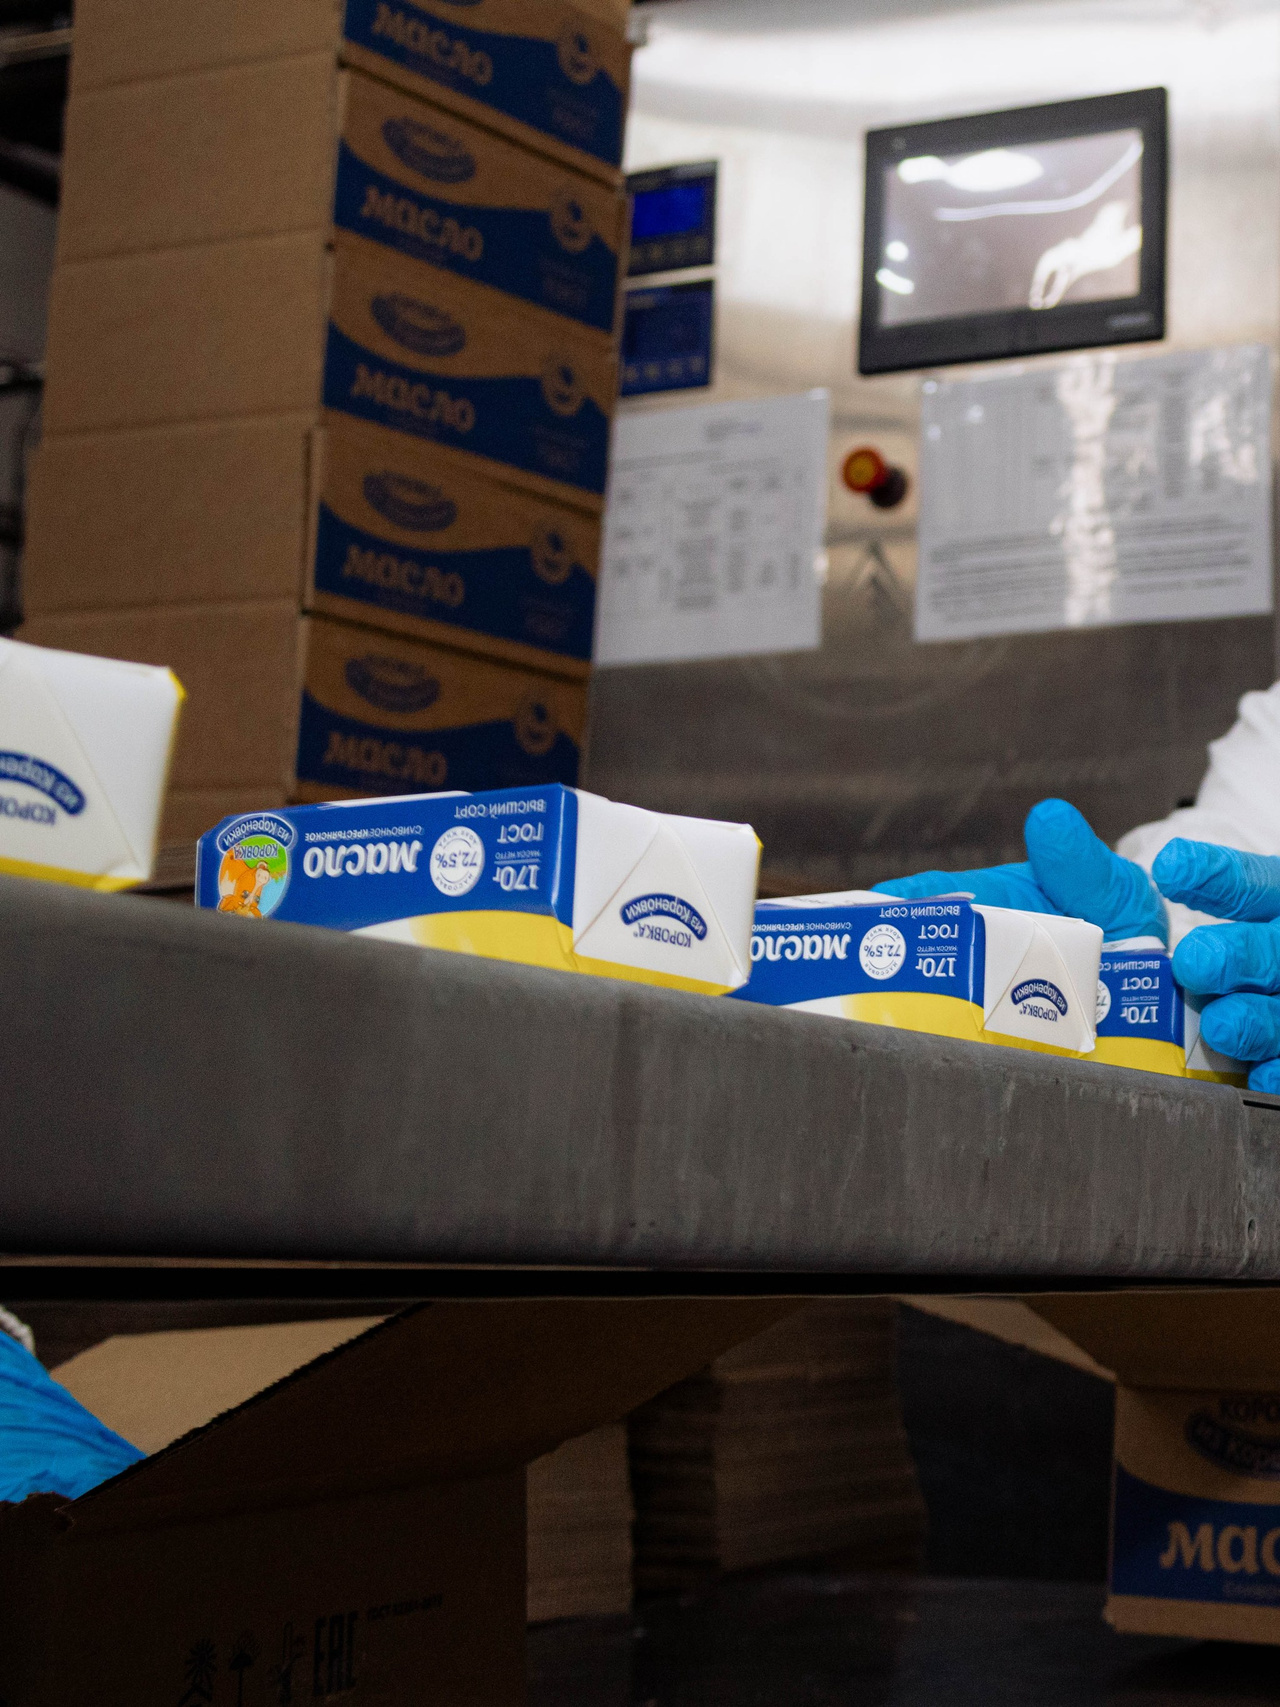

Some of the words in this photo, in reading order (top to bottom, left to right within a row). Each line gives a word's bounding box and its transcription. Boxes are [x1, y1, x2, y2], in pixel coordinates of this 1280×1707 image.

[372, 2, 493, 87] масло
[360, 184, 485, 262] масло
[349, 363, 477, 434] масло
[342, 544, 465, 609] масло
[322, 730, 448, 788] масло
[454, 803, 487, 819] СОРТ
[488, 799, 546, 819] ВЫСШИЙ
[497, 822, 544, 844] ГОСТ
[303, 839, 424, 879] масло
[435, 849, 477, 869] 72,5%
[492, 864, 540, 891] 170г
[878, 906, 909, 918] СОРТ
[910, 905, 960, 919] ВЫСШИЙ
[918, 923, 960, 940] ГОСТ
[751, 933, 852, 962] масло
[863, 943, 902, 958] 72,5%
[915, 957, 957, 978] 170г
[1113, 960, 1160, 973] ВЫСШИЙ
[1121, 976, 1160, 990] ГОСТ
[1120, 1005, 1159, 1024] 170г
